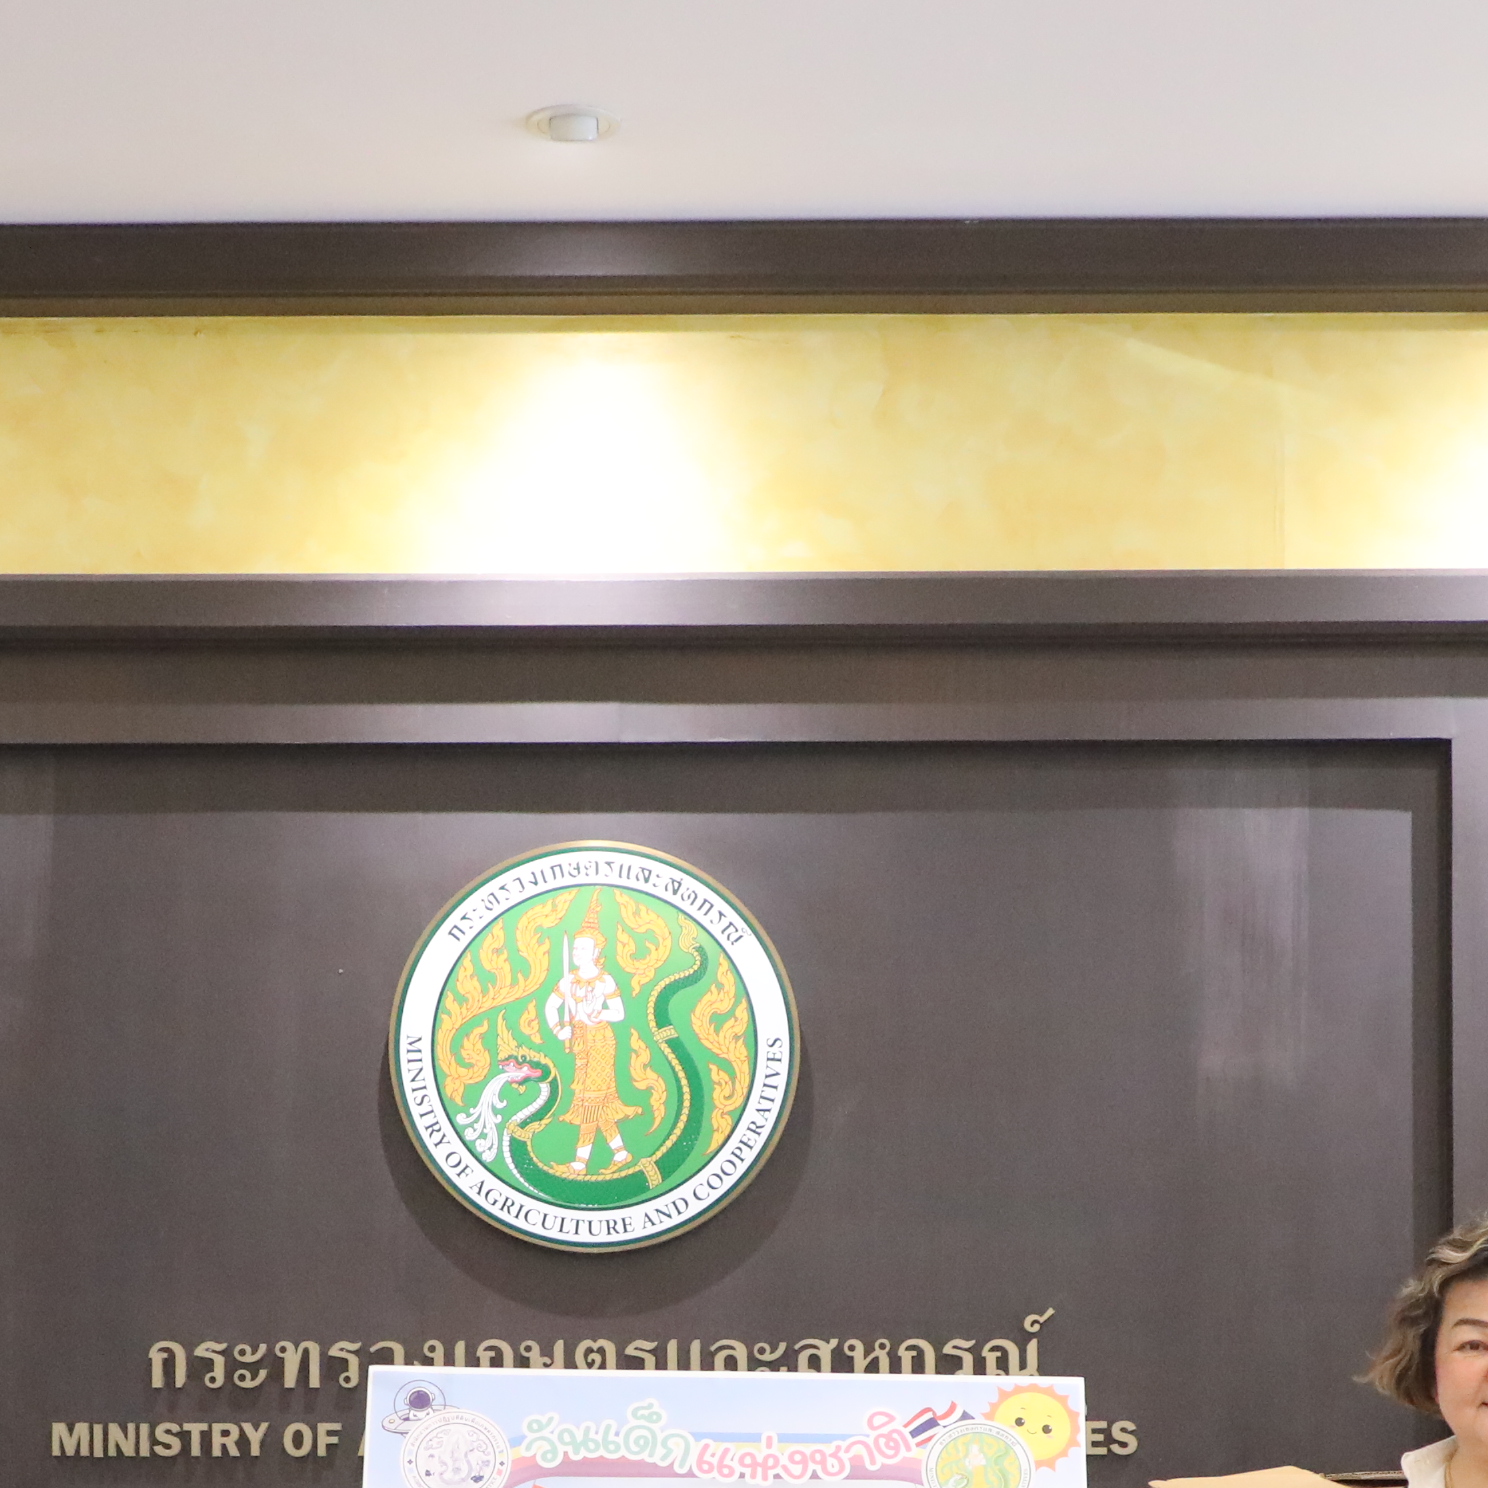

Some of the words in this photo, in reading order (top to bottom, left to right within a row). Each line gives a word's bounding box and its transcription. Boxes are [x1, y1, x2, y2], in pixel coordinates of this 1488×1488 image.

[405, 1034, 453, 1150] MINISTRY
[444, 1150, 474, 1181] OF
[468, 1178, 636, 1237] AGRICULTURE
[641, 1197, 690, 1230] AND
[691, 1036, 785, 1203] COOPERATIVES
[51, 1421, 269, 1458] MINISTRY
[283, 1421, 342, 1458] OF
[524, 1402, 912, 1480] วันเด็กแห่งชาติ
